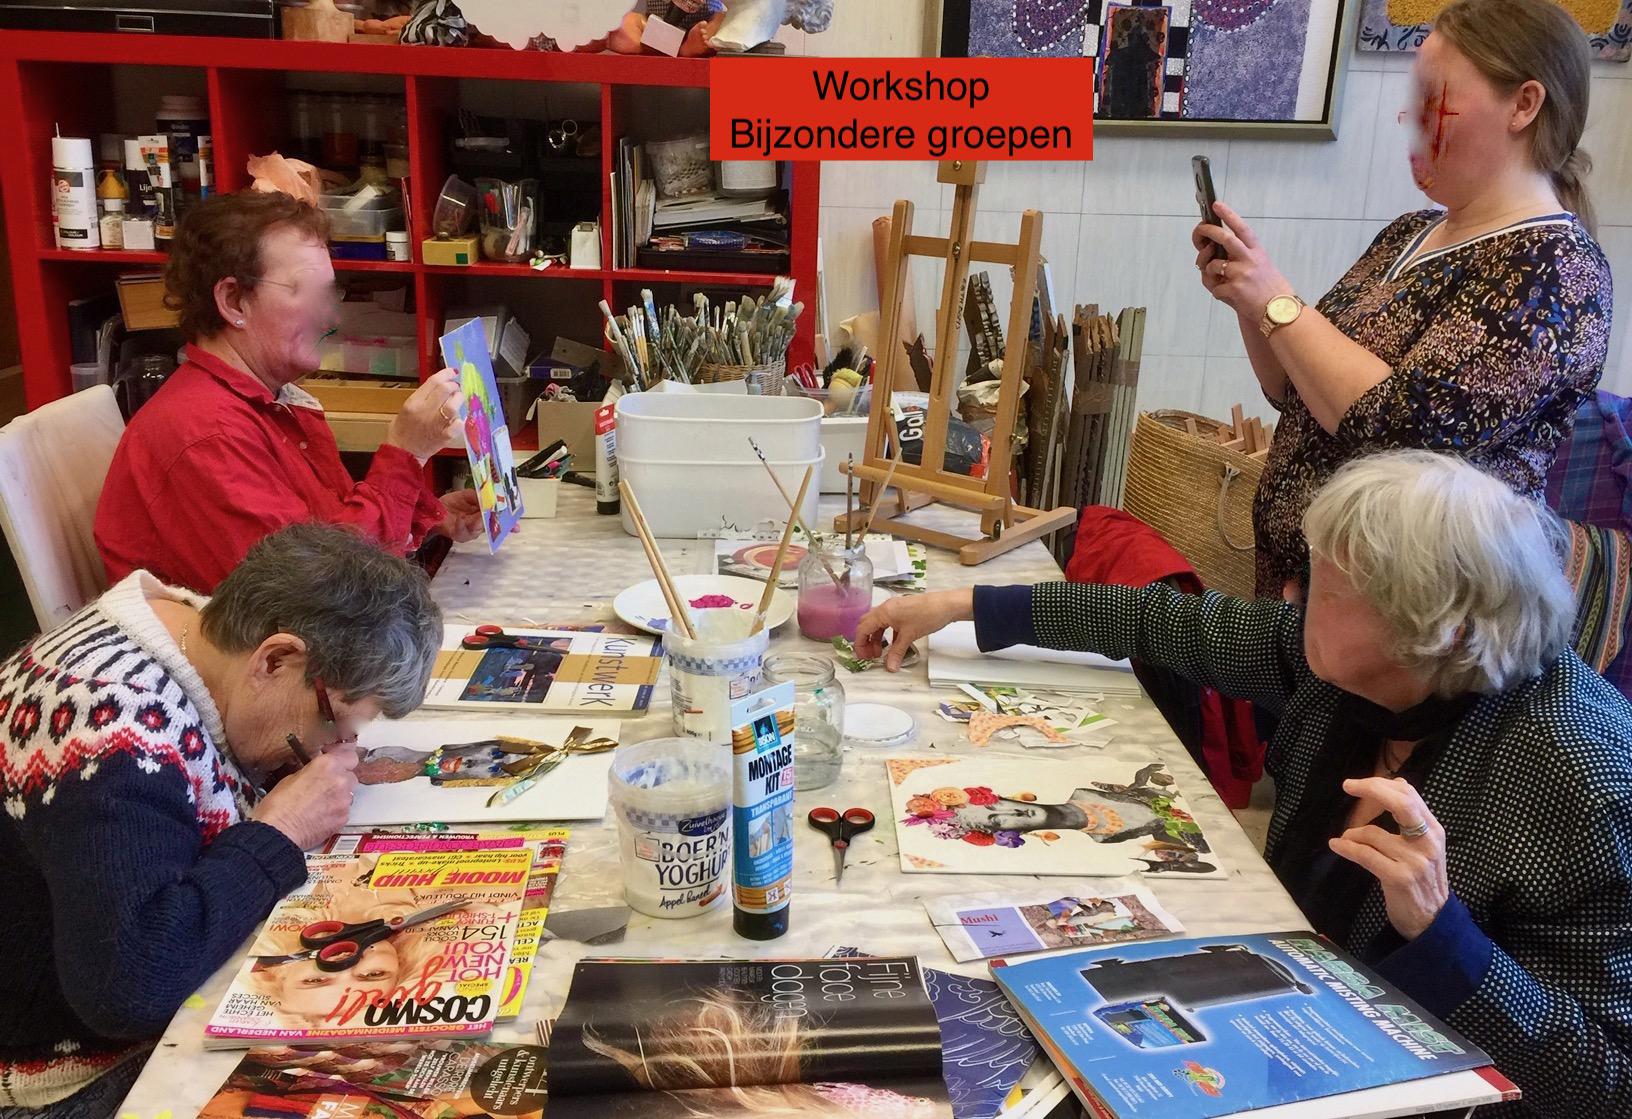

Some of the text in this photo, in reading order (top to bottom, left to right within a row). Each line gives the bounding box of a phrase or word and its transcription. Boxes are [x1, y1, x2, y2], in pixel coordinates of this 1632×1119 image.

[748, 744, 792, 781] MONTAGE
[765, 771, 780, 795] KIT
[372, 873, 439, 887] HUID
[442, 871, 526, 885] MOOIE
[659, 896, 685, 910] Appel
[960, 913, 999, 924] Mushi
[461, 925, 507, 940] 154
[444, 940, 507, 954] YOU!
[440, 953, 505, 968] NEW
[445, 966, 502, 982] HOT
[819, 962, 861, 1001] face
[857, 962, 911, 1003] Fijne
[760, 965, 813, 1018] dagen
[364, 994, 490, 1027] COSMO
[210, 1026, 276, 1036] NEDERLAND
[305, 1026, 406, 1036] MEIDENMAGAZINE
[408, 1024, 466, 1034] GROOTSTE
[466, 1022, 487, 1030] HET
[1328, 981, 1381, 1018] MISTING
[1372, 1019, 1438, 1061] MACHINE
[430, 1052, 459, 1096] CARASSO
[446, 1056, 471, 1093] DEIRDRE
[483, 1059, 509, 1099] uitgelicht
[492, 1049, 529, 1110] & kunstenaars
[509, 1056, 537, 1106] ontwerpers
